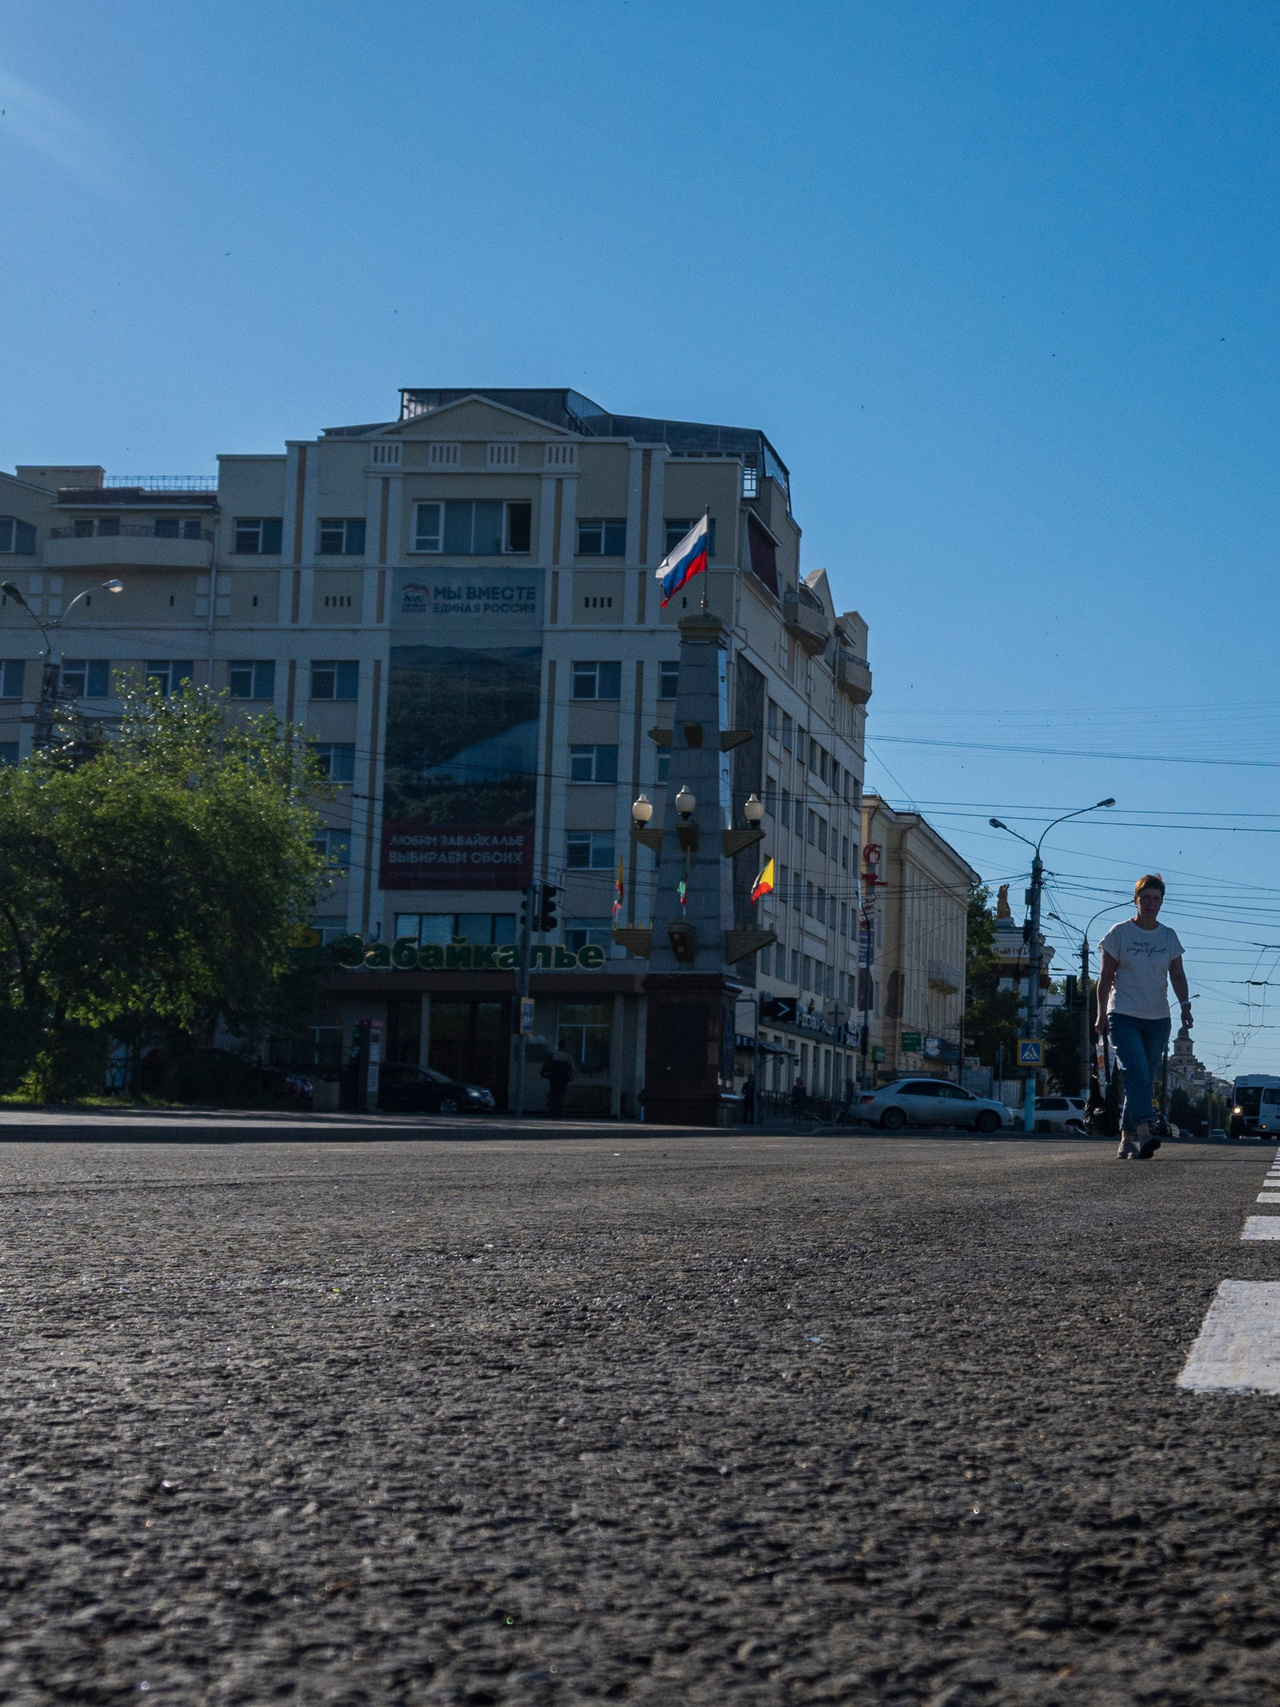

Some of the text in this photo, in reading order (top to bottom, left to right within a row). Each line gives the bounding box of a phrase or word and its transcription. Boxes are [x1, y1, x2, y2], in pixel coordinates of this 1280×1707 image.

[433, 586, 536, 600] МЫ ВМЕСТЕ
[433, 603, 480, 614] ЕДИНАЯ
[483, 603, 535, 613] РОССИЯ
[390, 833, 524, 846] ЛЮБИМ ЗАБАЙКАЛЬЕ
[388, 851, 522, 864] ВЫБИРАЕМ СВОИХ
[335, 934, 606, 970] Забайкалье
